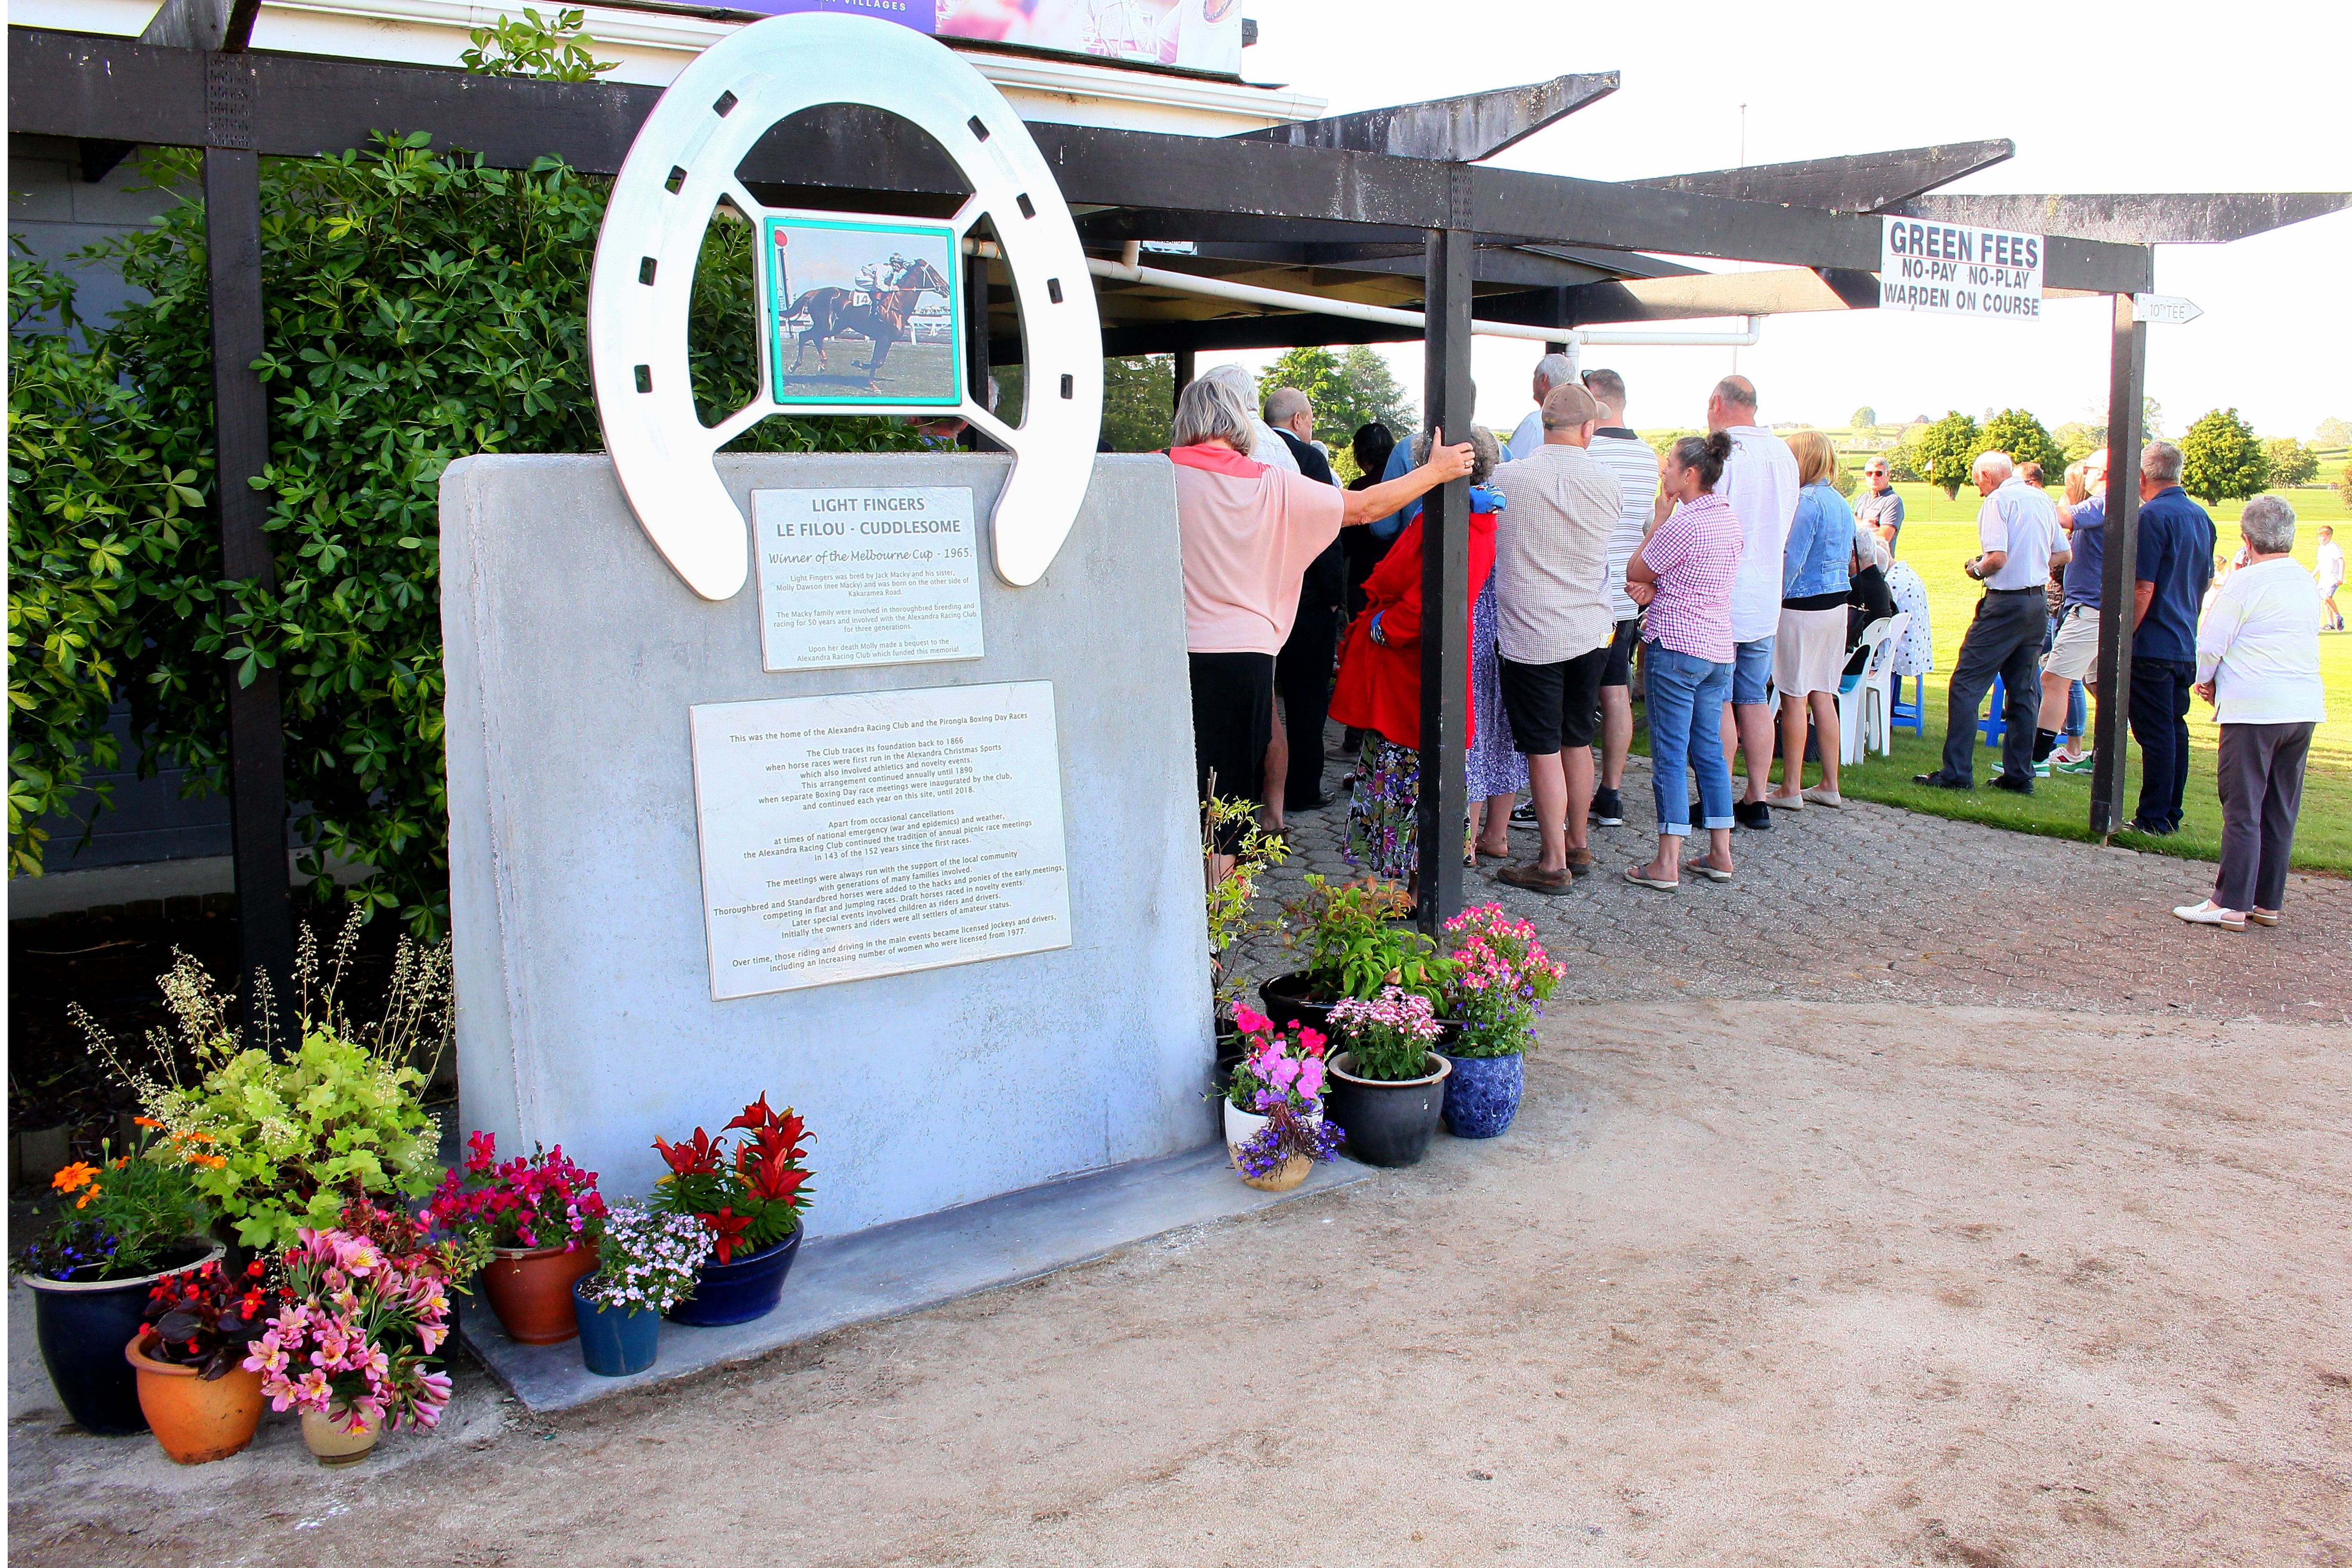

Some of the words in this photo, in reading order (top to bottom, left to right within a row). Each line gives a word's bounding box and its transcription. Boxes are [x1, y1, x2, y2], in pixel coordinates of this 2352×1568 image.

[1890, 221, 1972, 262] GREEN
[1980, 233, 2037, 269] FEES
[1902, 258, 1957, 282] NO-PAY
[1969, 266, 2030, 289] NO-PLAY
[856, 294, 869, 305] 14
[1883, 282, 1949, 308] WARDEN
[1956, 290, 1976, 310] ON
[1983, 293, 2040, 317] COURSE
[2167, 305, 2185, 319] TEE
[812, 498, 858, 512] LIGHT
[864, 498, 924, 511] FINGERS
[777, 524, 795, 537] LE
[800, 522, 844, 536] FILOU
[860, 520, 960, 534] CUDDLESOME
[768, 553, 812, 564] Winner
[815, 550, 828, 565] of
[828, 550, 850, 562] the
[851, 549, 911, 561] Melbourne
[912, 549, 933, 562] Cup
[944, 547, 972, 558] 1965.
[790, 574, 807, 583] Light
[889, 605, 932, 613] thoroughbred
[874, 623, 913, 632] generations.
[803, 728, 811, 737] of
[827, 725, 865, 734] Alexandra
[892, 721, 909, 729] Club
[911, 719, 924, 728] and
[939, 716, 968, 725] Pirongia
[823, 748, 840, 756] Club
[877, 742, 916, 751] foundation
[918, 739, 935, 748] back
[946, 736, 964, 745] 1866
[800, 770, 822, 779] which
[841, 765, 871, 775] involved
[874, 763, 904, 772] athletics
[906, 760, 919, 769] and
[921, 759, 946, 767] novelty
[803, 802, 816, 810] and
[818, 798, 855, 808] continued
[857, 796, 874, 804] each
[875, 796, 891, 804] year
[937, 788, 953, 796] until
[955, 786, 975, 794] 2018.
[828, 820, 849, 829] Apart
[870, 812, 907, 824] occasional
[909, 809, 954, 820] cancellations
[824, 852, 838, 860] 143
[840, 850, 849, 858] of
[880, 846, 899, 855] years
[813, 913, 839, 925] special
[841, 911, 864, 920] events
[866, 906, 896, 916] involved
[898, 903, 927, 912] children
[961, 895, 973, 904] and
[975, 893, 1001, 901] drivers.
